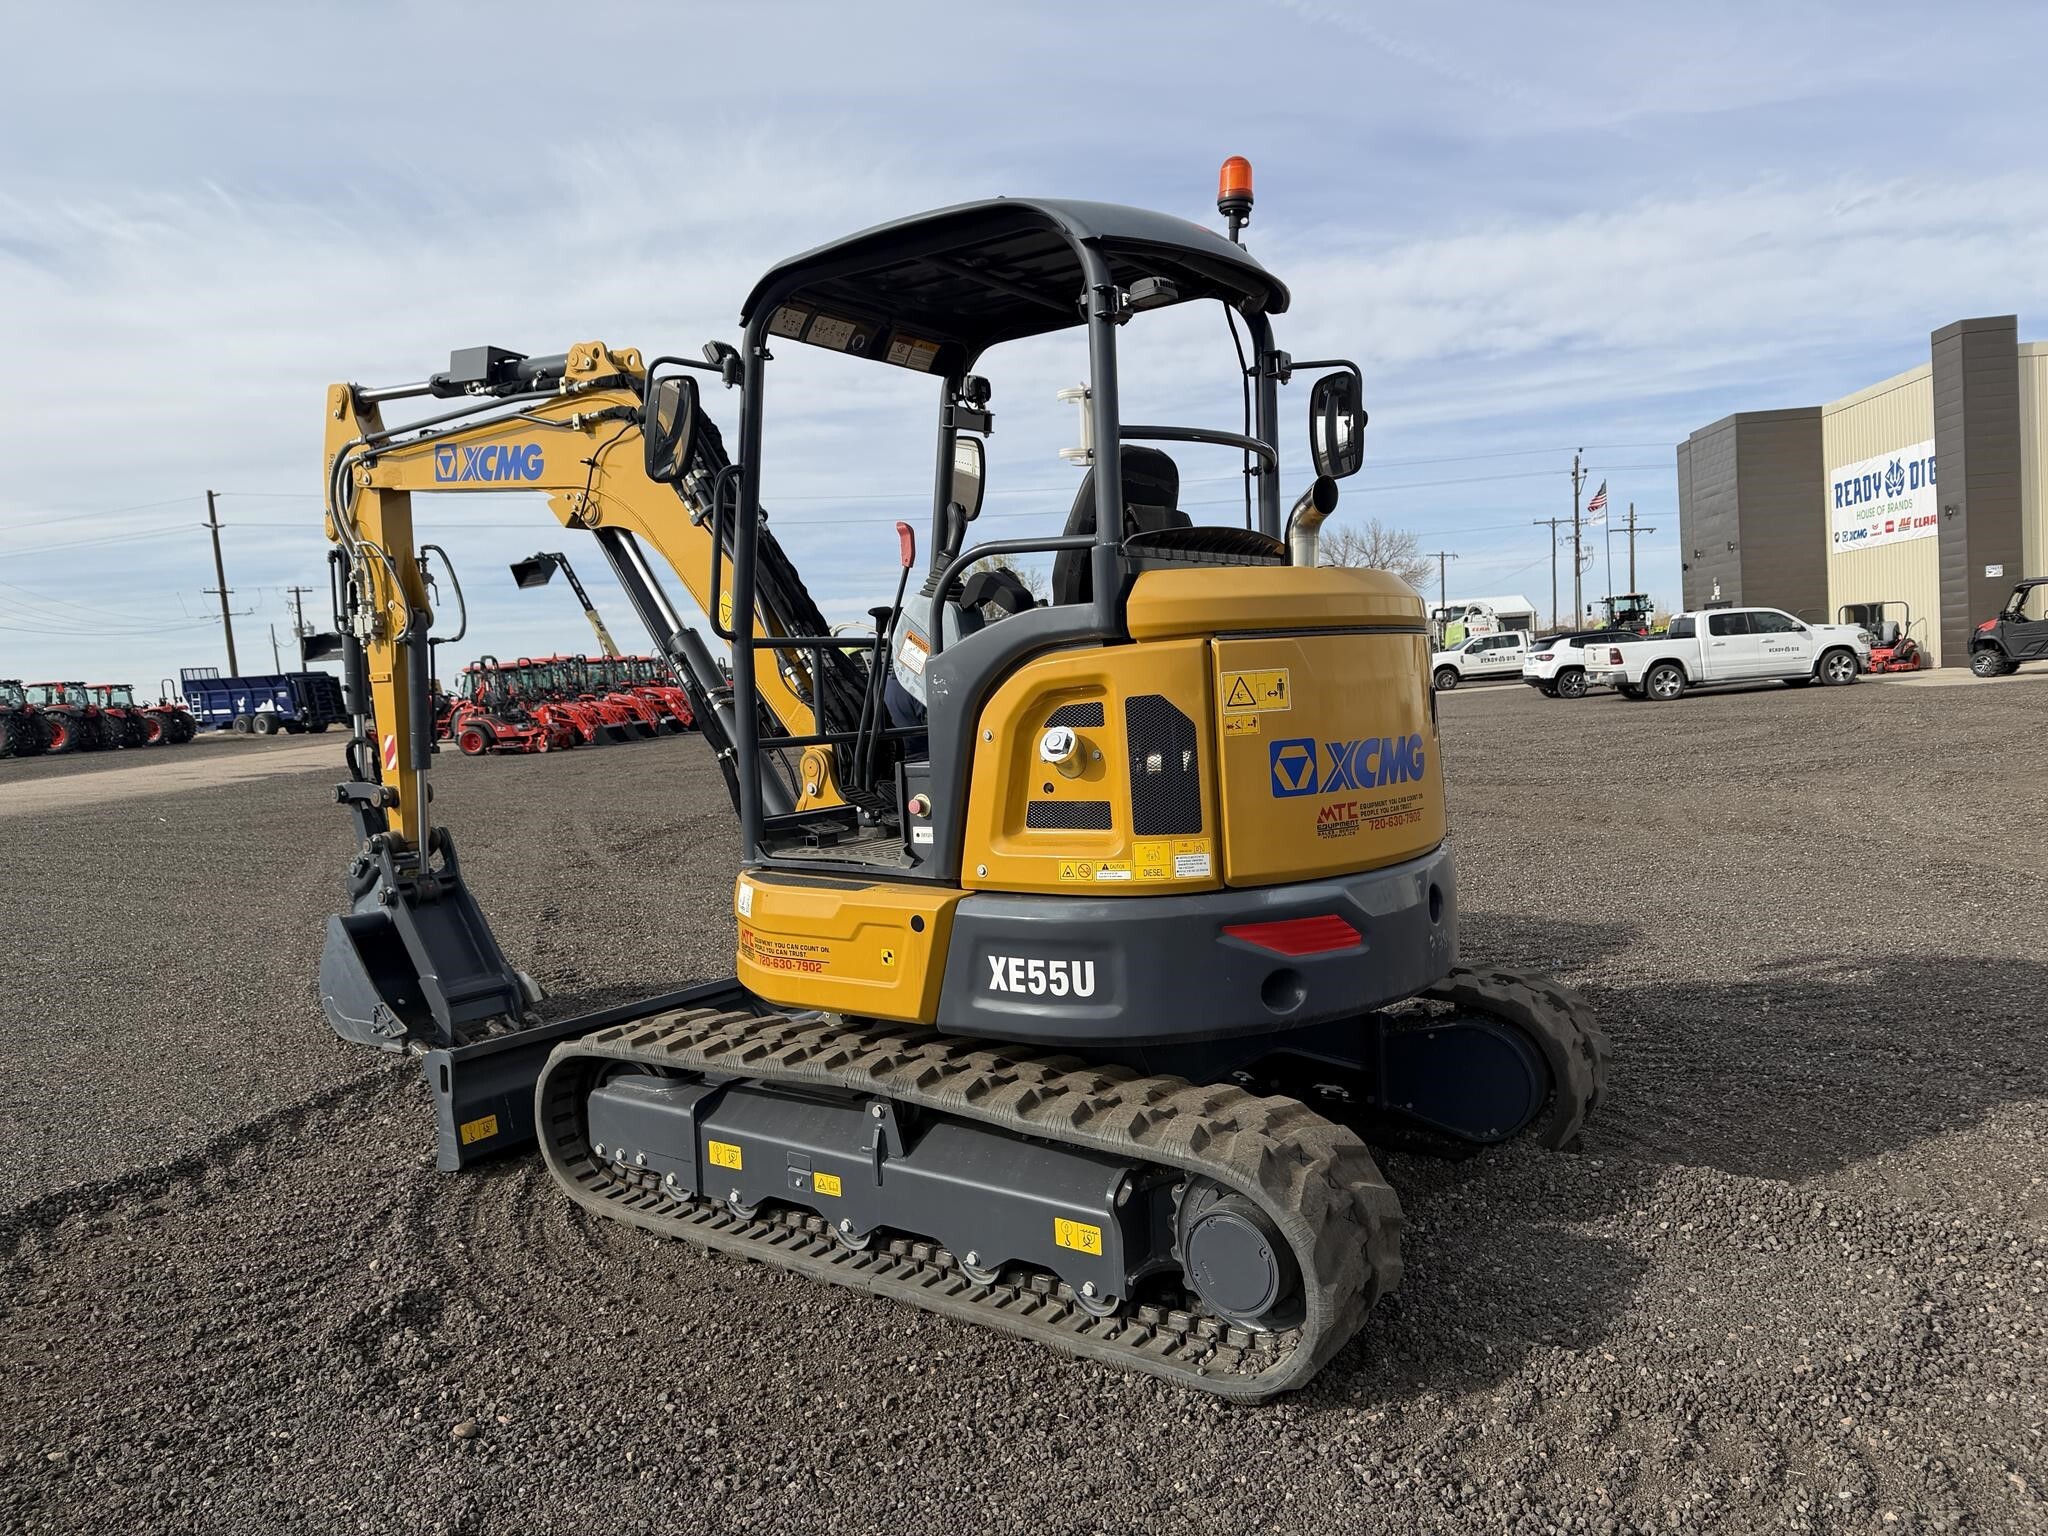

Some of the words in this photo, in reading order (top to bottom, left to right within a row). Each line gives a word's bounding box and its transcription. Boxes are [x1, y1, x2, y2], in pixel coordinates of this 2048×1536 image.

[458, 443, 545, 482] XCMG
[1834, 471, 1882, 509] READY
[1908, 455, 1937, 490] DIG
[1856, 504, 1875, 520] HOUSE
[1876, 503, 1885, 516] OF
[1887, 499, 1912, 513] BRANDS
[1899, 517, 1911, 527] JLG
[1319, 733, 1425, 793] XCMG
[1316, 801, 1359, 823] MTC
[1360, 800, 1388, 810] EQUIPMENT
[1360, 808, 1379, 817] PEOPLE
[1390, 804, 1399, 812] CAN
[1317, 820, 1359, 829] EQUIPMENT
[1369, 812, 1421, 830] 720-630-7902
[1143, 868, 1165, 877] DIESEL
[799, 944, 819, 952] COUNT
[759, 954, 822, 973] 720-630-7902
[987, 955, 1095, 997] XE55U
